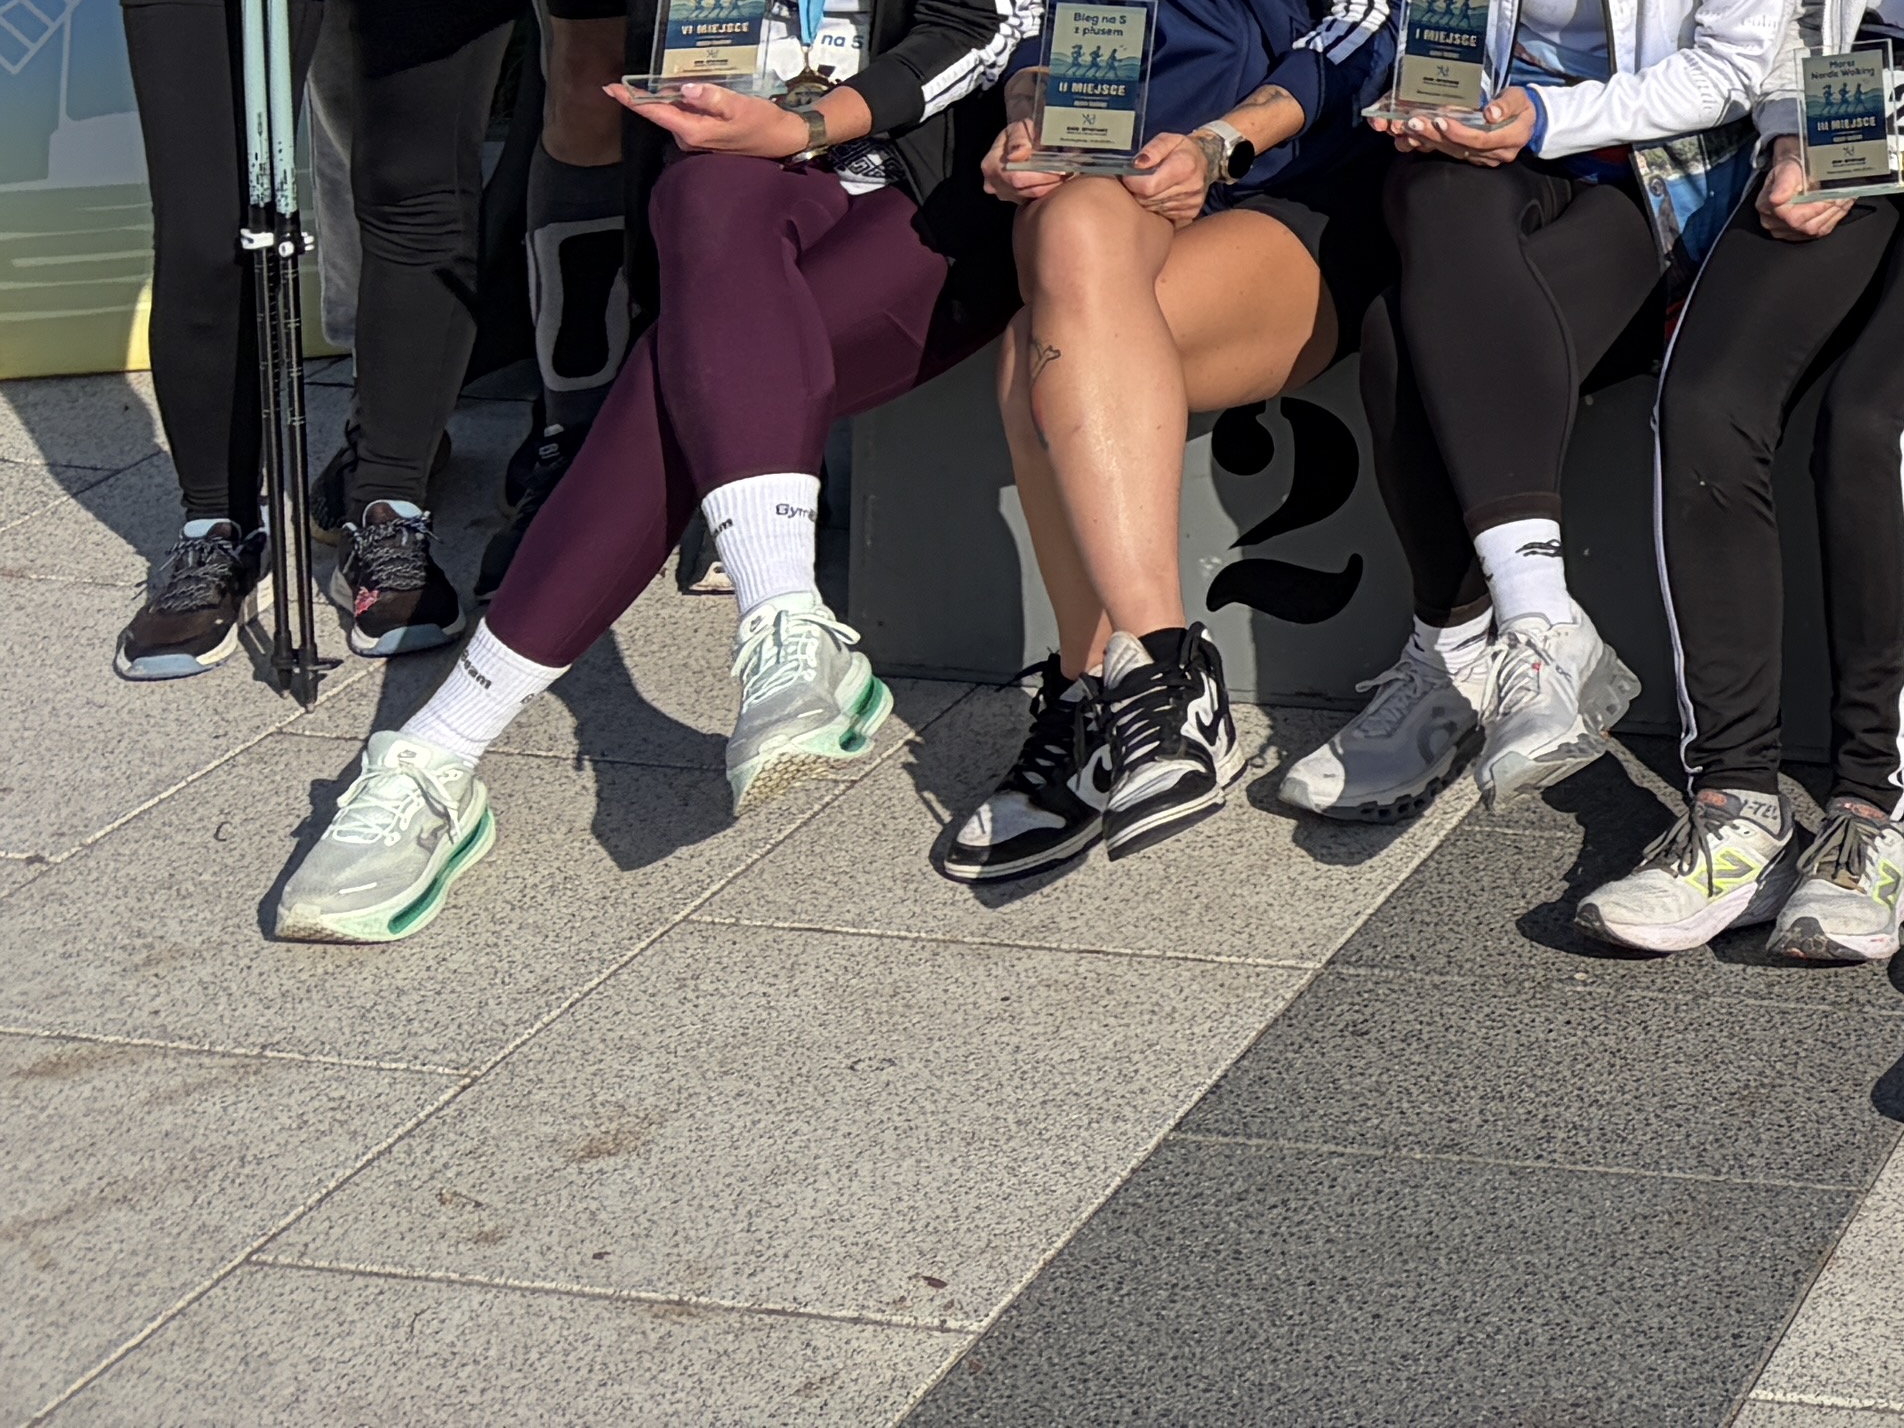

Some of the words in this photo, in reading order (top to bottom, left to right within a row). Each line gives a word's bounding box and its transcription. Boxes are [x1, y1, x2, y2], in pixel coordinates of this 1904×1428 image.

[1073, 11, 1099, 26] Bieg
[1101, 14, 1117, 24] na
[696, 21, 750, 35] MIEJSCE
[820, 33, 845, 47] na
[851, 34, 864, 50] 5
[1423, 29, 1478, 48] MIEJSCE
[1071, 82, 1126, 97] MIEJSCE
[1830, 116, 1876, 129] MIEJSCE
[1205, 396, 1364, 624] 2
